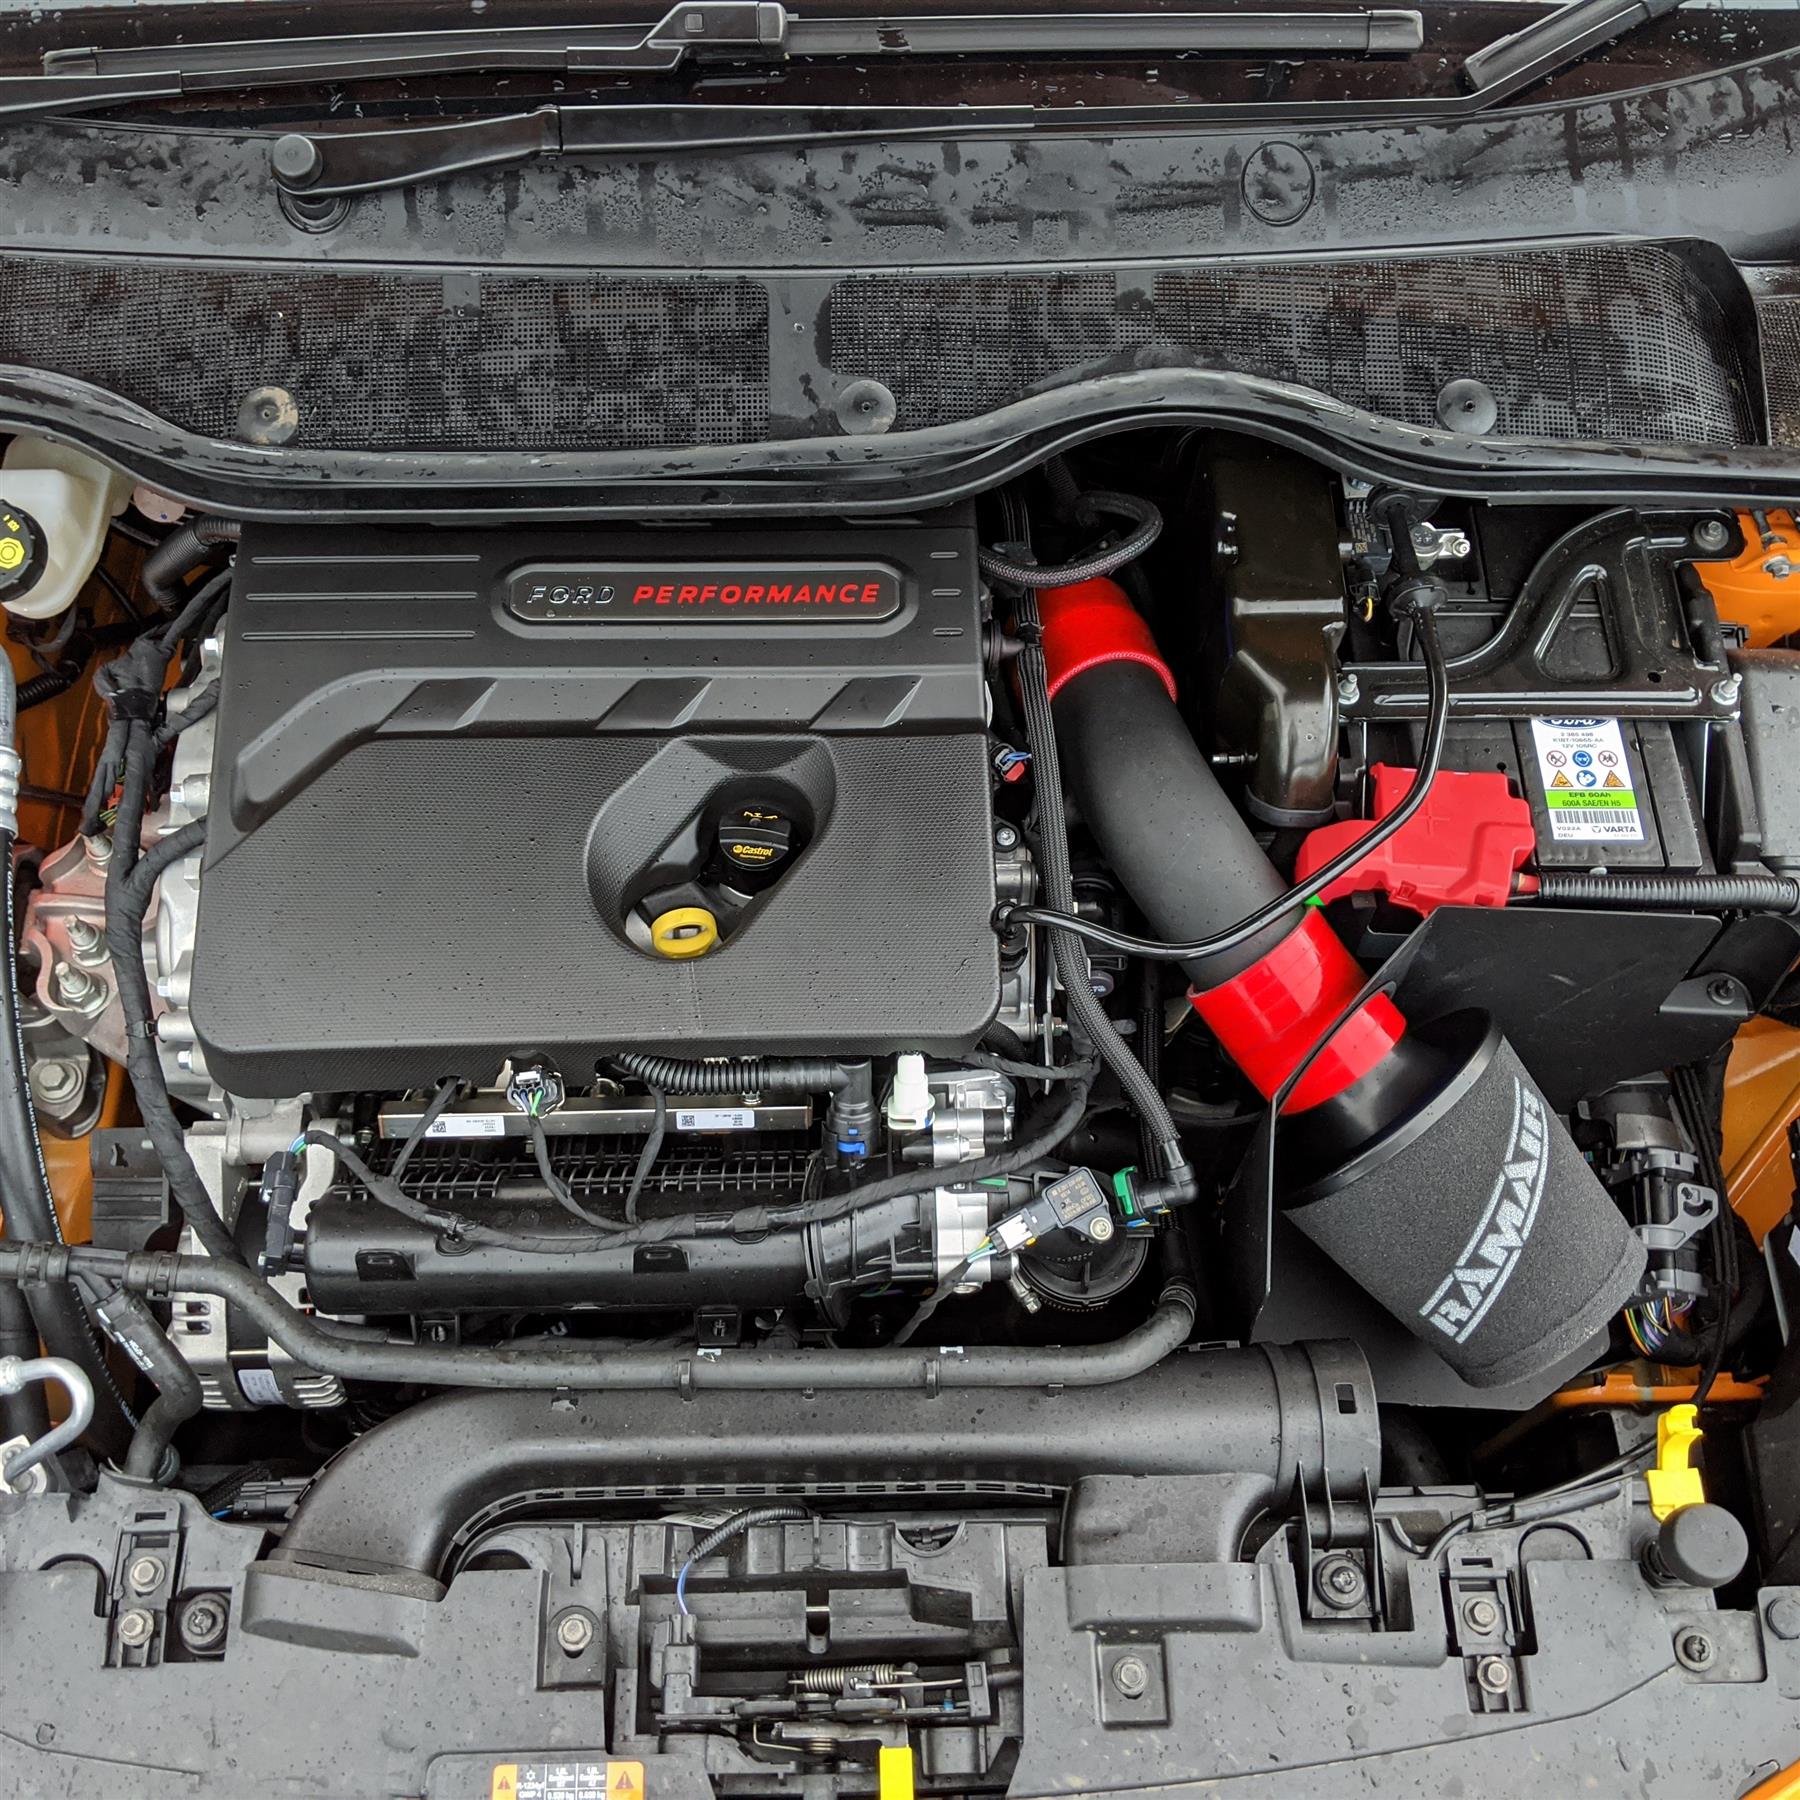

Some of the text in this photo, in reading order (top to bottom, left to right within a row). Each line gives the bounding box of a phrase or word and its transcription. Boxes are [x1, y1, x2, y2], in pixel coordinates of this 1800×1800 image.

[527, 583, 880, 605] FORD PERFORMANCE
[742, 845, 773, 856] Castrol
[1429, 1087, 1543, 1337] RAMAIR
